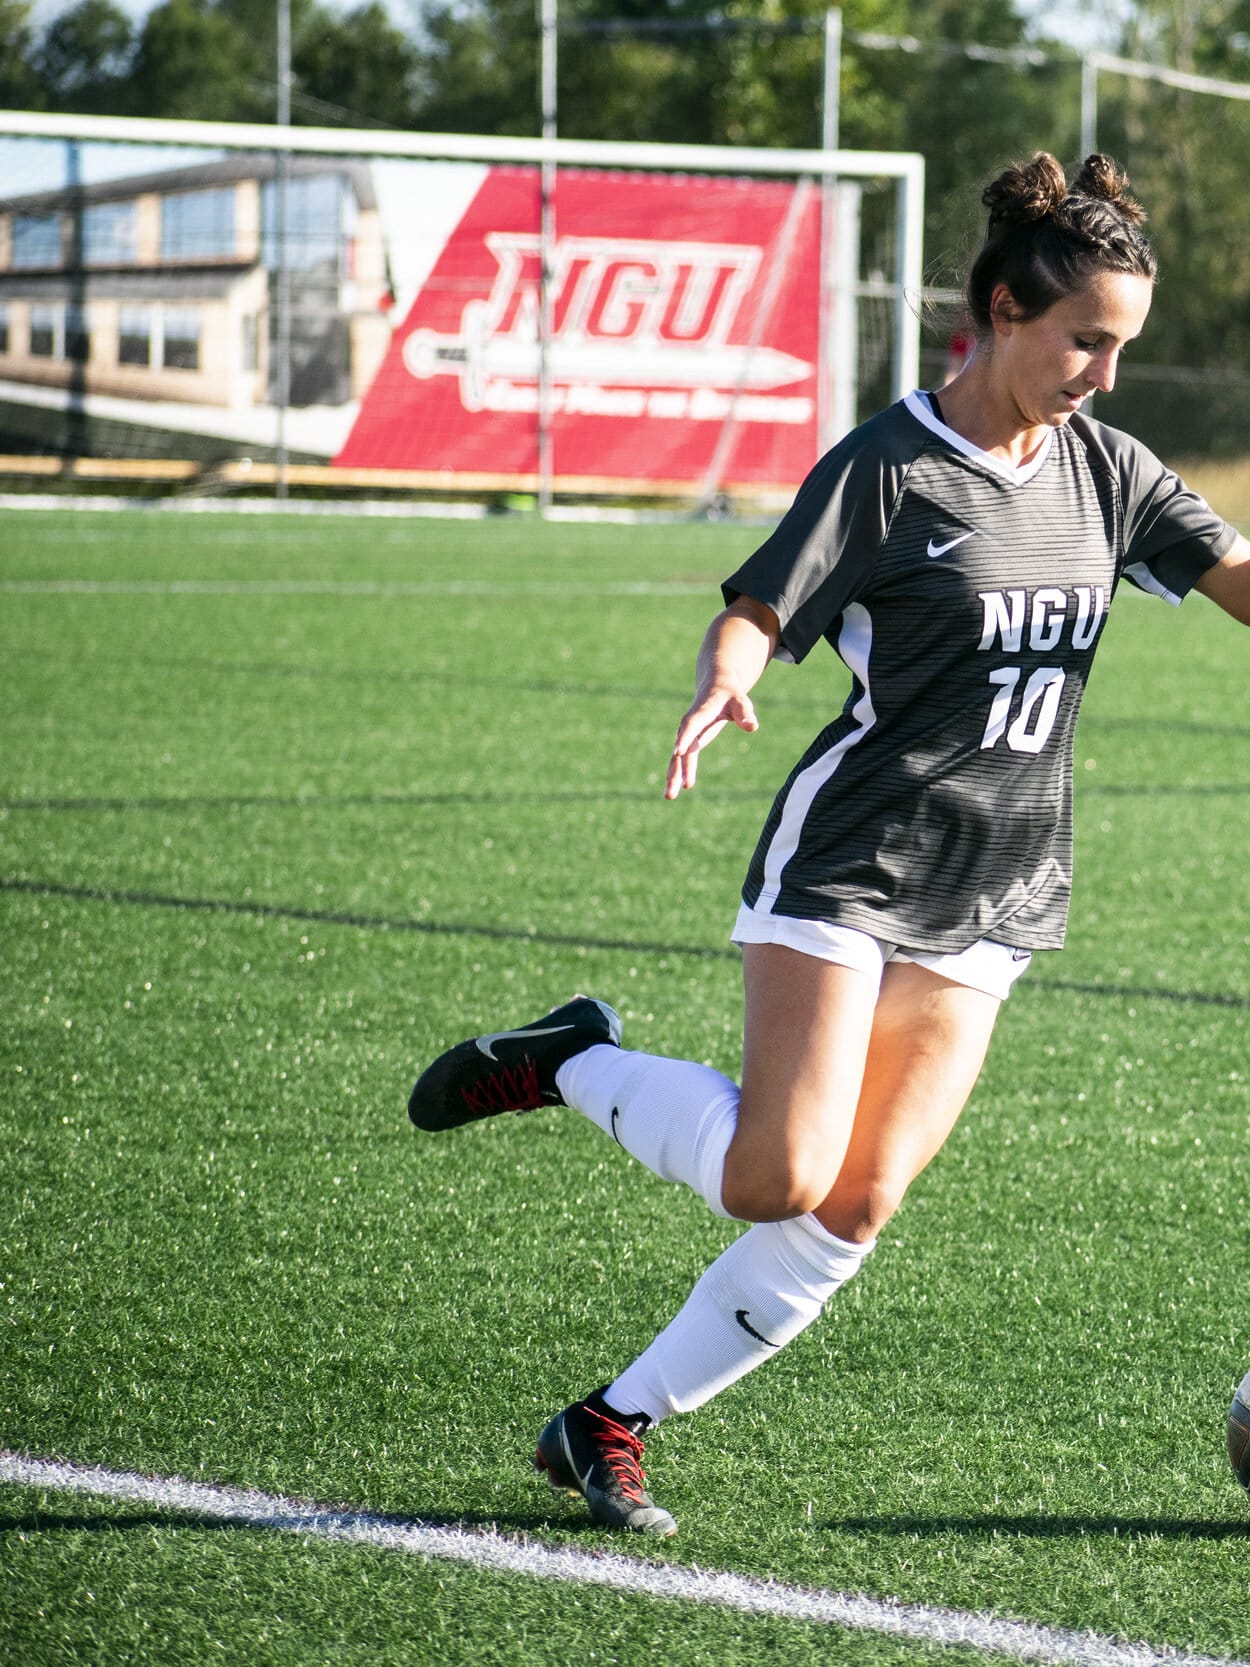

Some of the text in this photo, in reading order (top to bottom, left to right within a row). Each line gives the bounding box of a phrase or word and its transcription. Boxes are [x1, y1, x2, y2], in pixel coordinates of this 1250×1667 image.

[484, 232, 763, 343] NGU
[976, 585, 1105, 653] NGU
[979, 665, 1067, 755] 10
